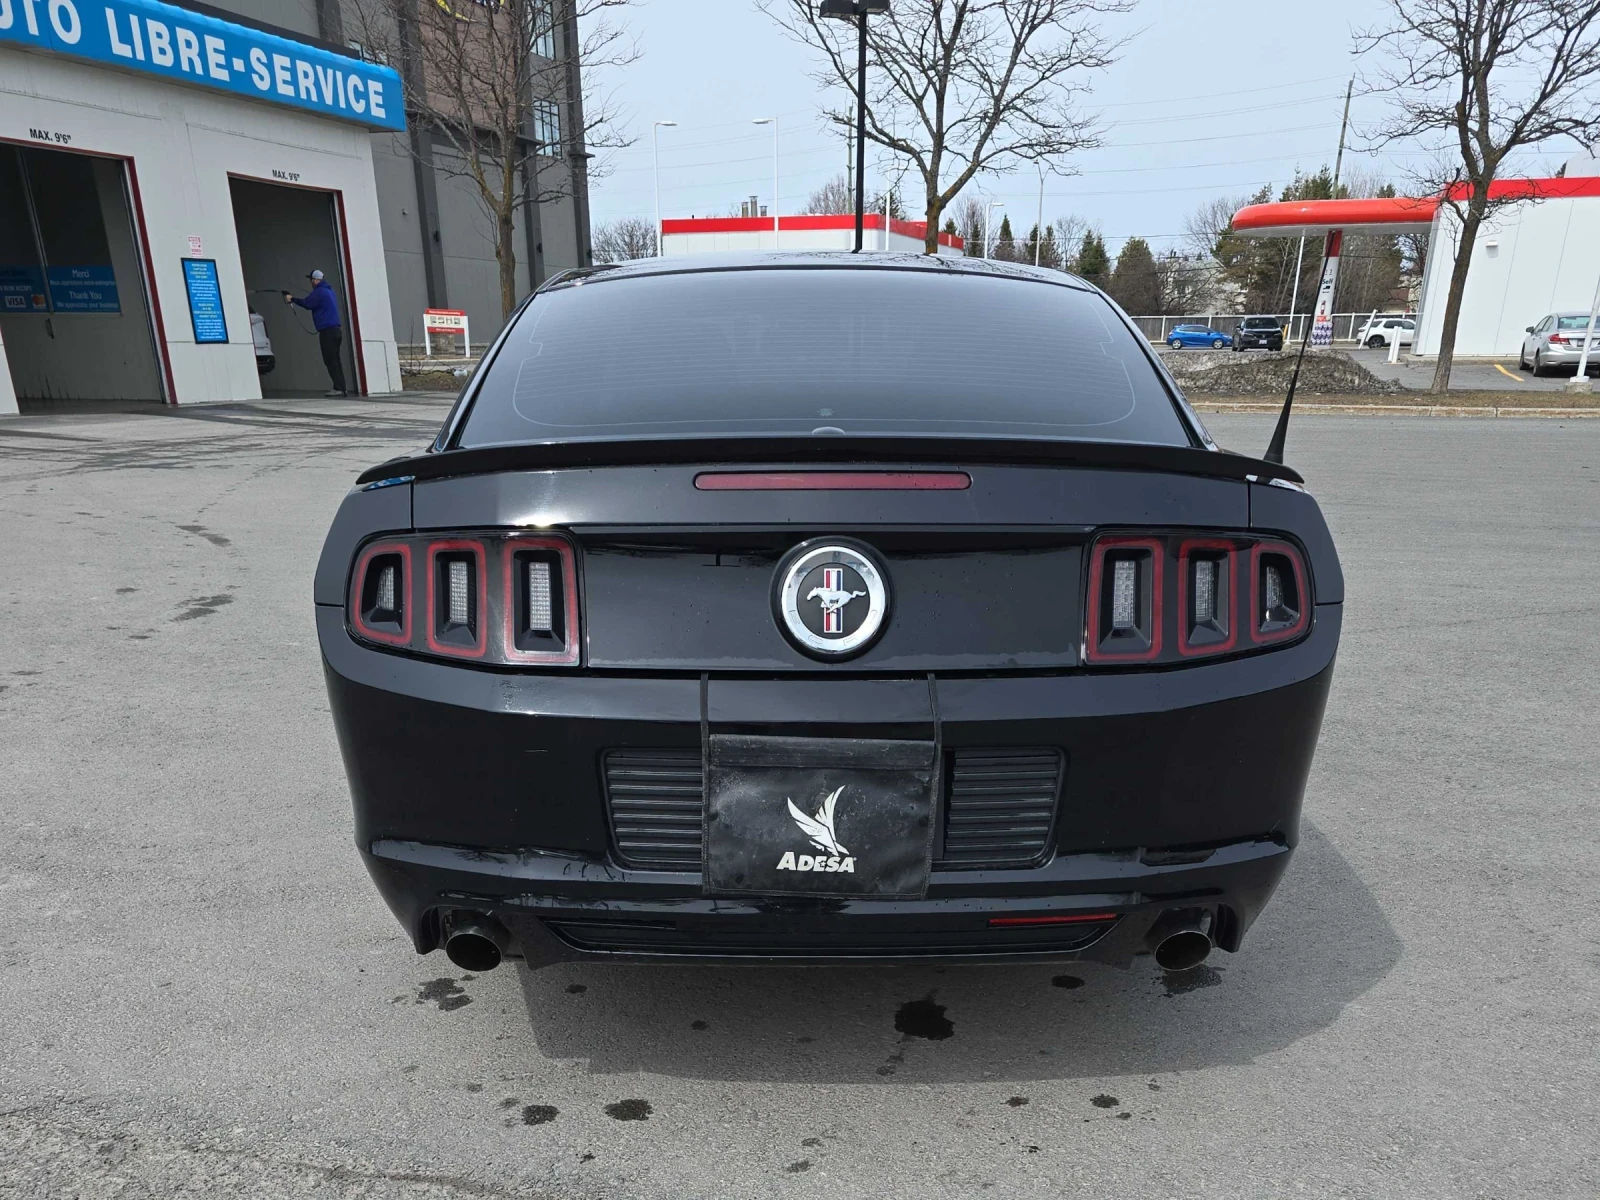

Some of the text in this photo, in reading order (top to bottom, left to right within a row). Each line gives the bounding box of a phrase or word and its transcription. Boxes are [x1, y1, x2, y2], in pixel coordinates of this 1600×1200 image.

[105, 7, 386, 119] LIBRE-SERVICE
[29, 128, 53, 141] MAX.
[272, 169, 288, 180] MAX.
[72, 269, 90, 278] Merci
[69, 291, 102, 300] Thank You
[7, 297, 24, 306] VISA
[776, 851, 856, 873] ADESA
